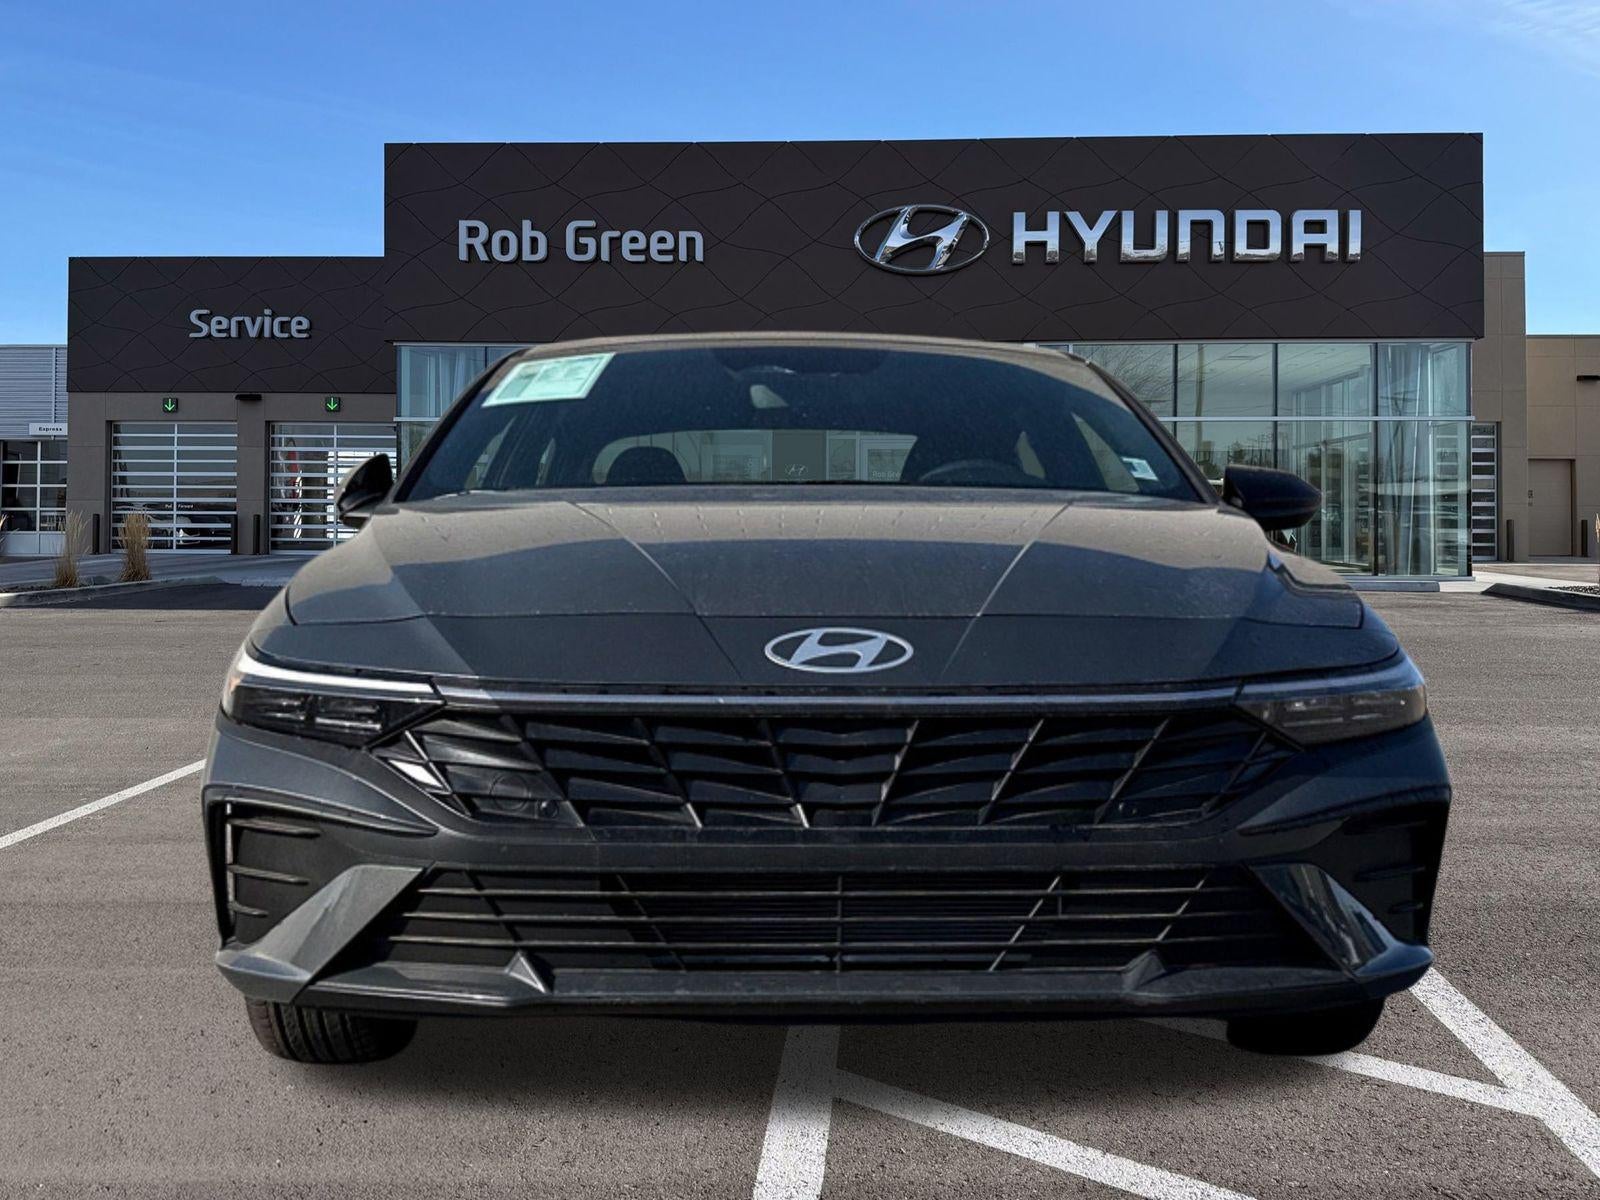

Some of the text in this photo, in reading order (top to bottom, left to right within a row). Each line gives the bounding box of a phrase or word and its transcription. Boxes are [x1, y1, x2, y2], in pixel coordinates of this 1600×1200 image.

[458, 219, 705, 263] Rob Green
[1011, 209, 1362, 264] HYUNDAI
[188, 308, 311, 339] Service
